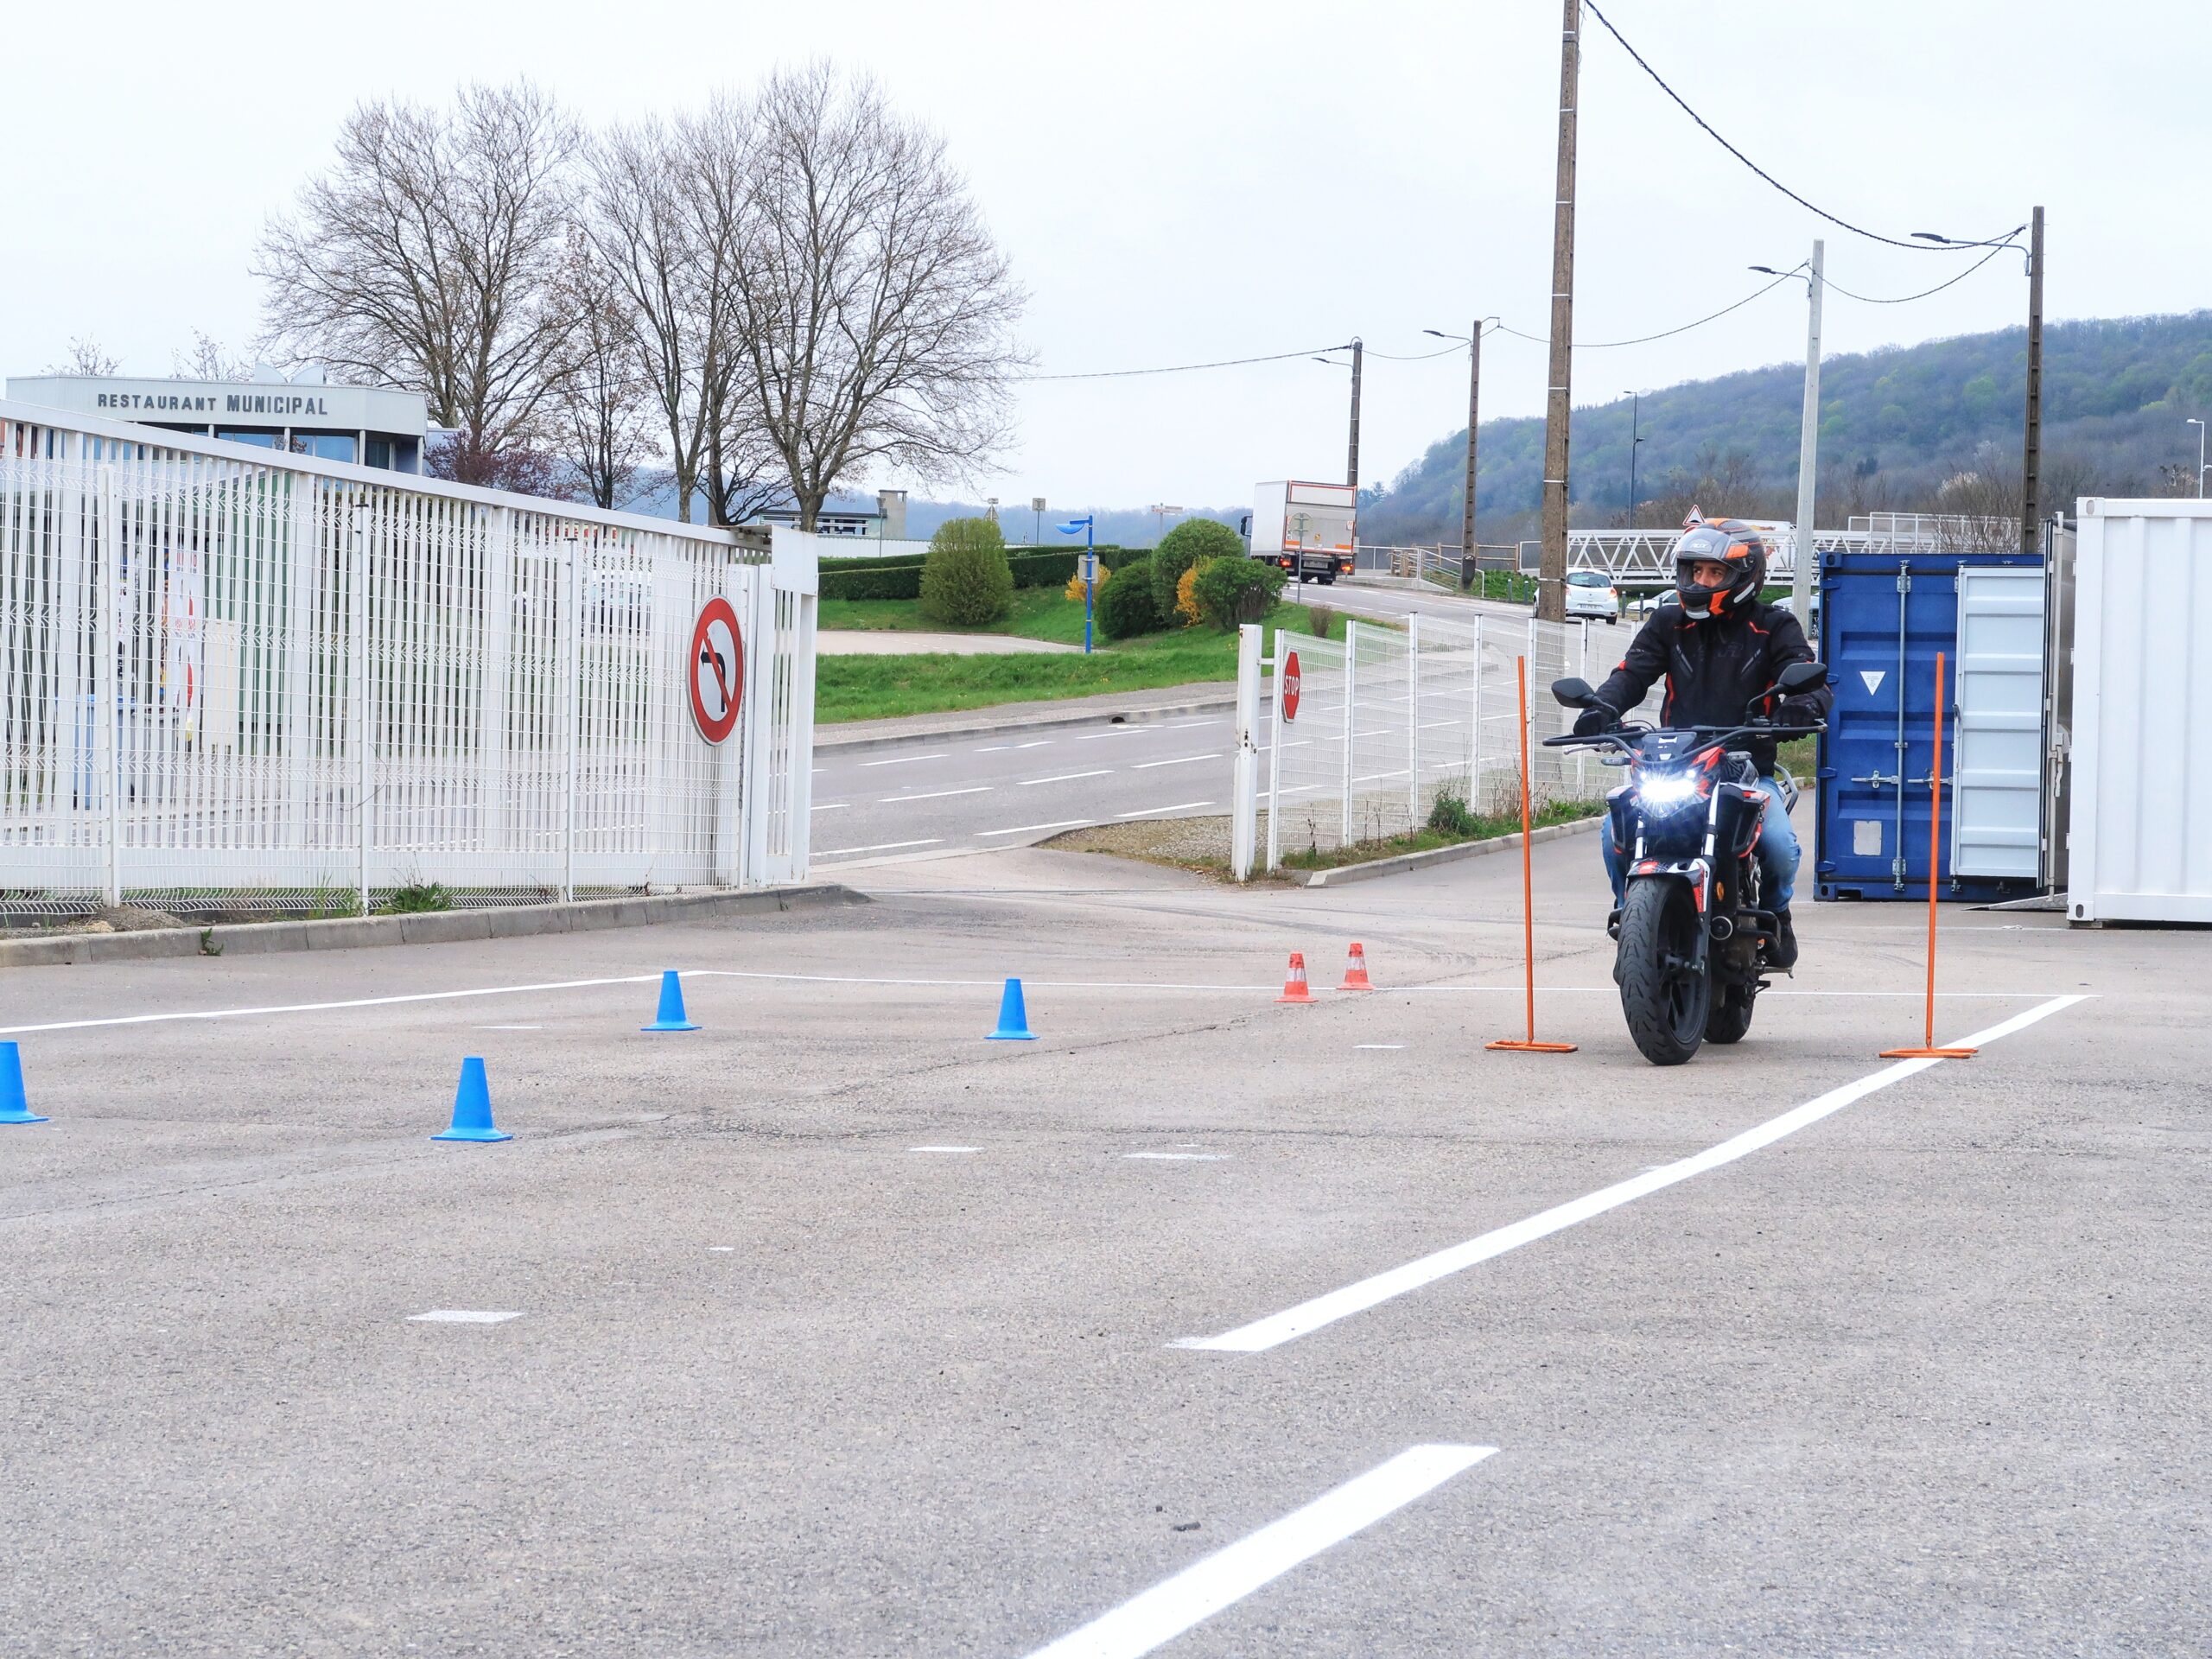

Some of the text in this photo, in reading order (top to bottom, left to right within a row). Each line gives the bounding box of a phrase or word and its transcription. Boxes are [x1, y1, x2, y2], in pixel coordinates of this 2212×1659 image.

[98, 393, 327, 415] RESTAURANT MUNICIPAL
[1284, 675, 1300, 696] STOP
